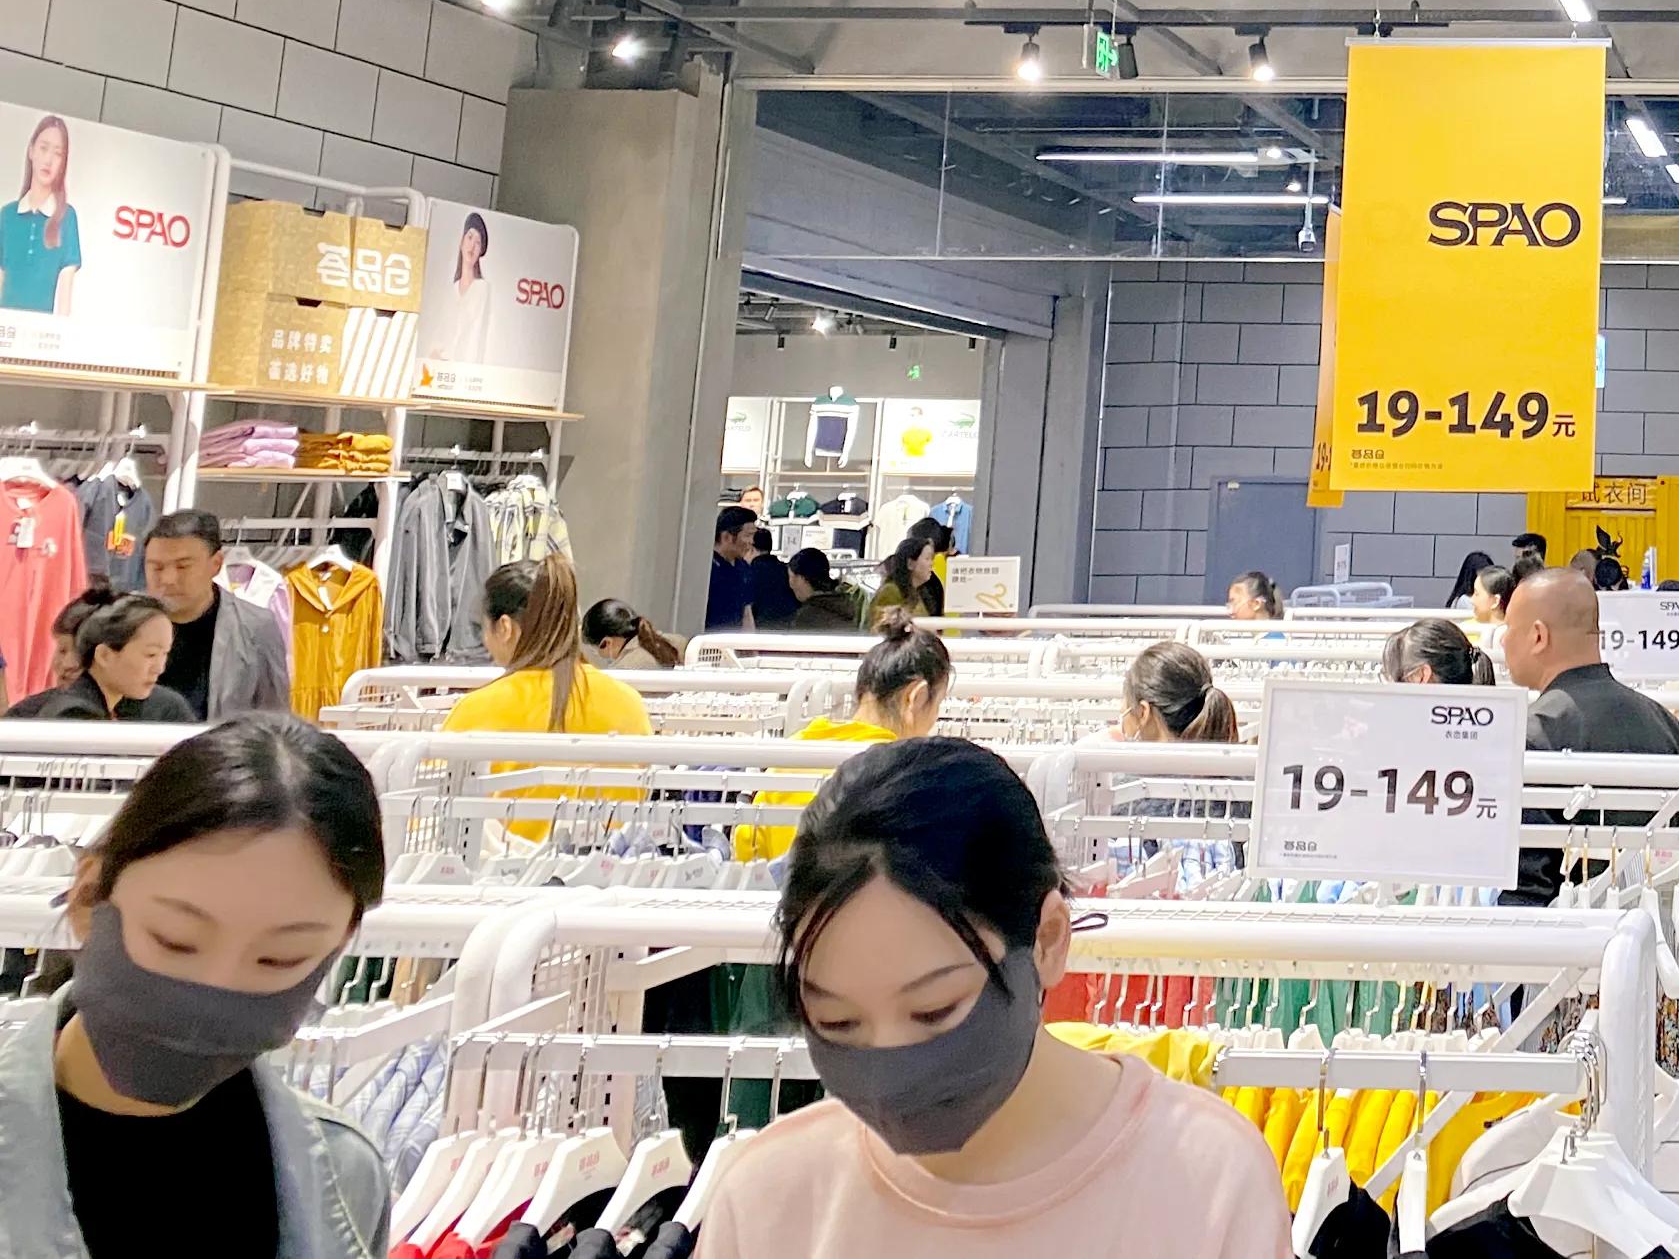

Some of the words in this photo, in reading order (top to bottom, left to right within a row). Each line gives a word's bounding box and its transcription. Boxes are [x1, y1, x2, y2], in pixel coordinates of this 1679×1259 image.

[112, 205, 191, 248] SPAO
[1428, 201, 1582, 247] SPAO
[516, 278, 565, 309] SPAO
[272, 329, 333, 354] 品牌特卖
[1431, 705, 1494, 727] SPAO
